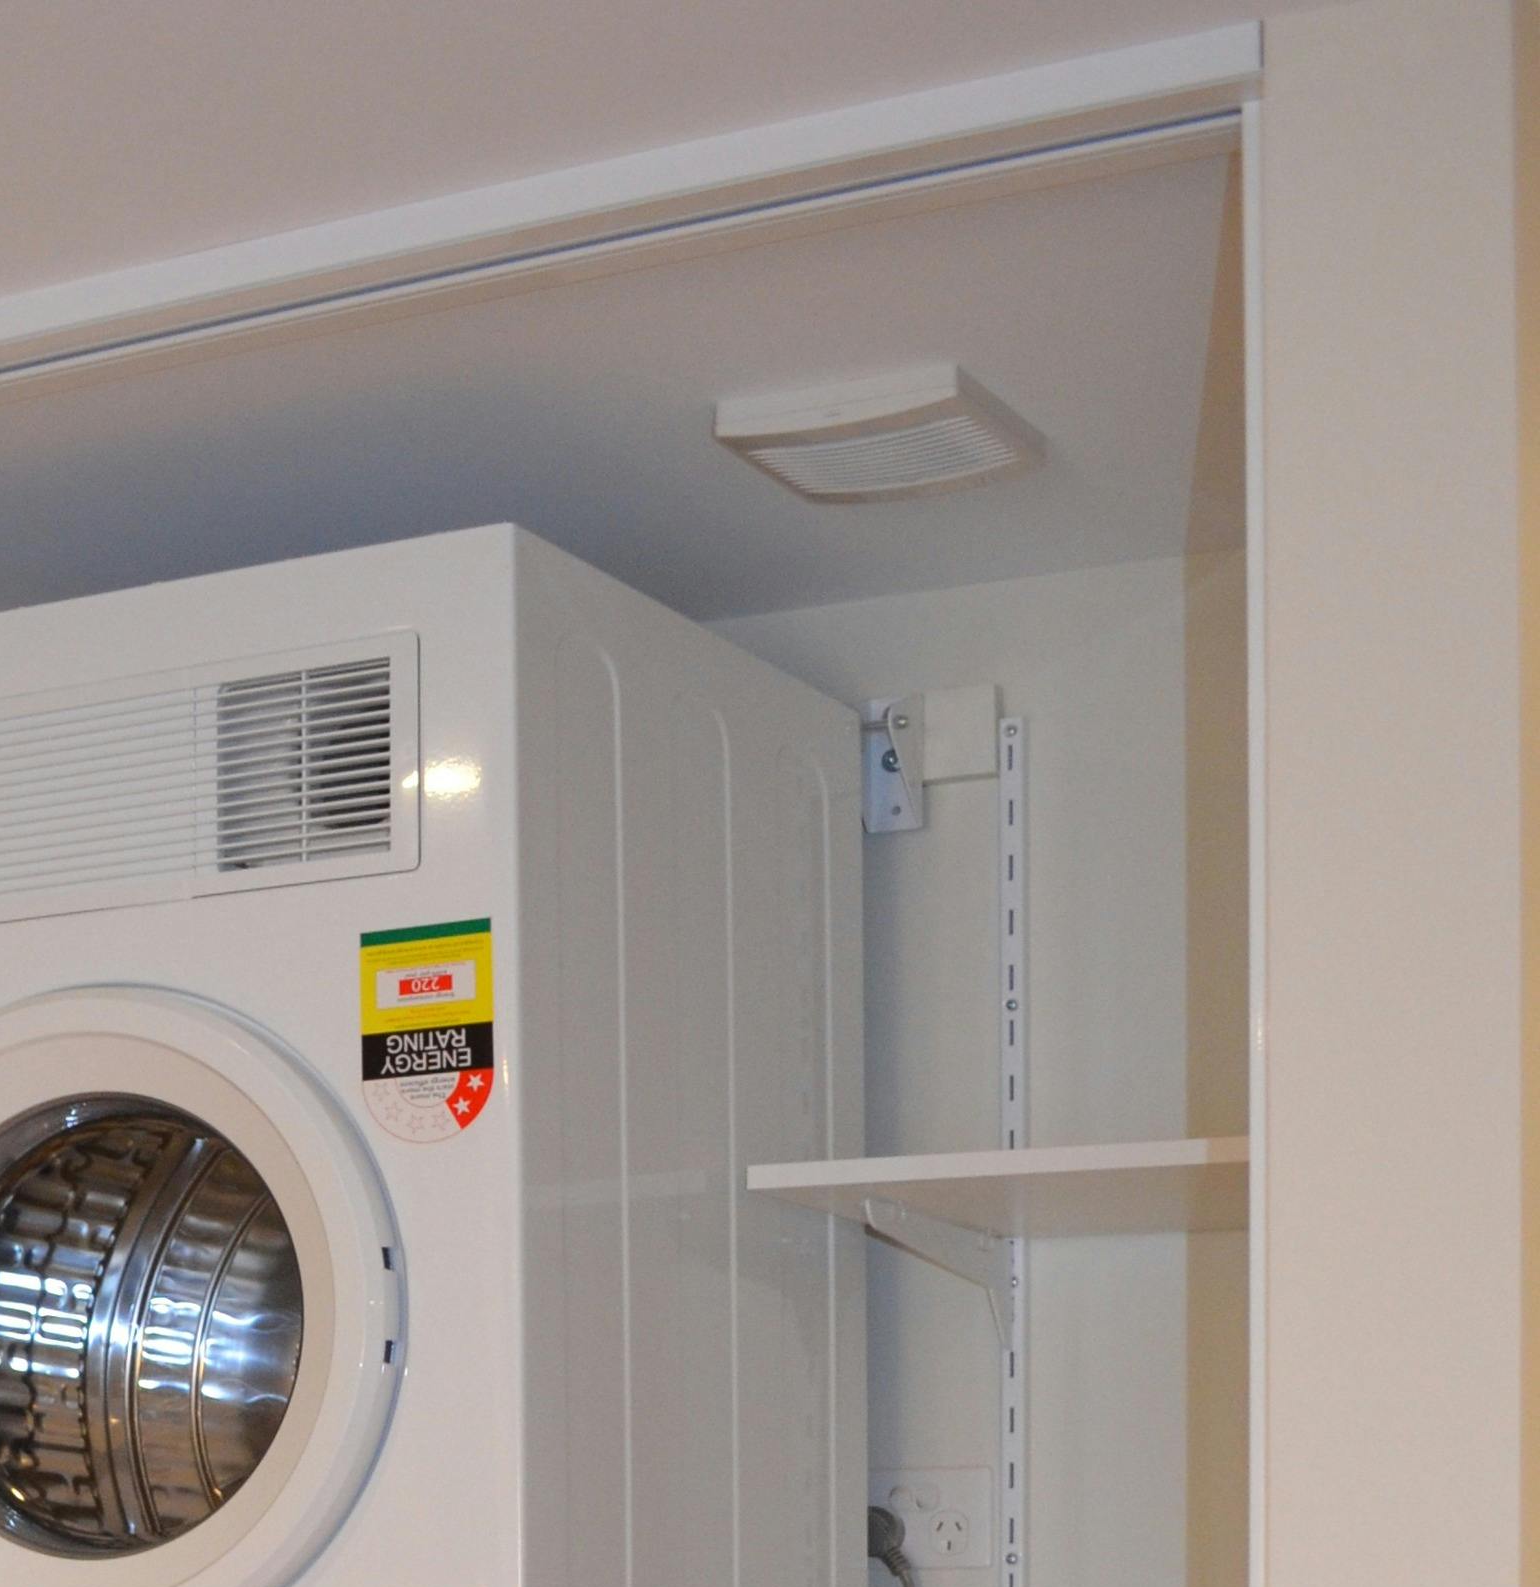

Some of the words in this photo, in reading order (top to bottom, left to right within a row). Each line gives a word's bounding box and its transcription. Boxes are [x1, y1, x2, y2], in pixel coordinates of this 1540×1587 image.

[411, 977, 440, 993] 220
[386, 1027, 466, 1055] RATING
[380, 1047, 472, 1075] ENERGY
